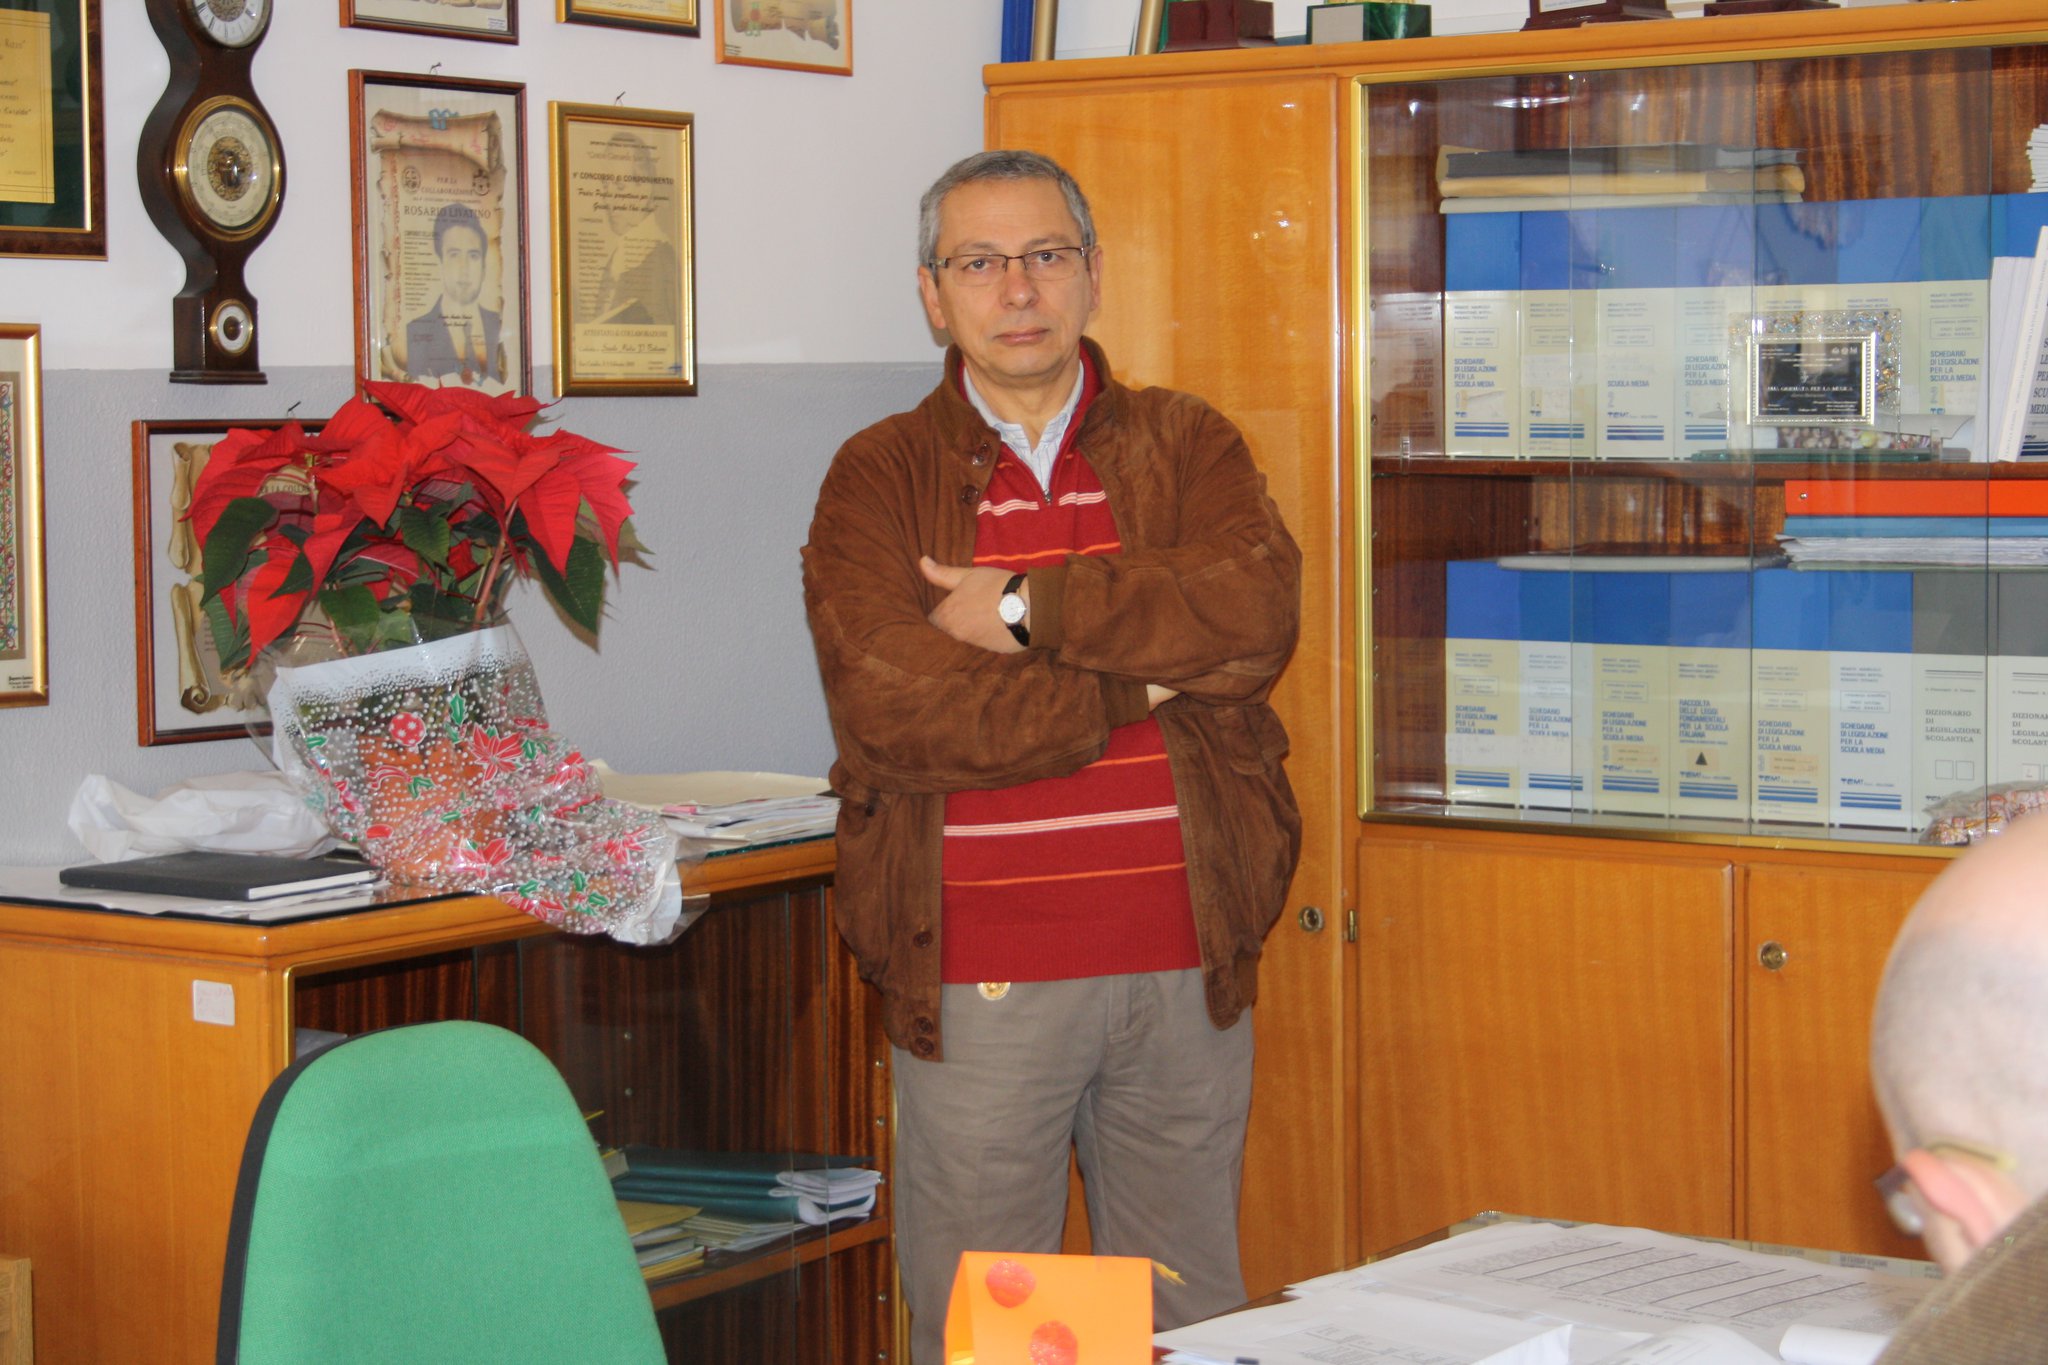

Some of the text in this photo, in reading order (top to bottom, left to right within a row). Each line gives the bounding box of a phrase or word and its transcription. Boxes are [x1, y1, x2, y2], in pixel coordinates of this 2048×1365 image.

[404, 206, 491, 219] ROSARIO LIVATINO
[1680, 714, 1726, 723] FONDAMENTALI
[1925, 726, 1981, 734] LEGISLAZIONE
[1865, 746, 1885, 754] MEDIA
